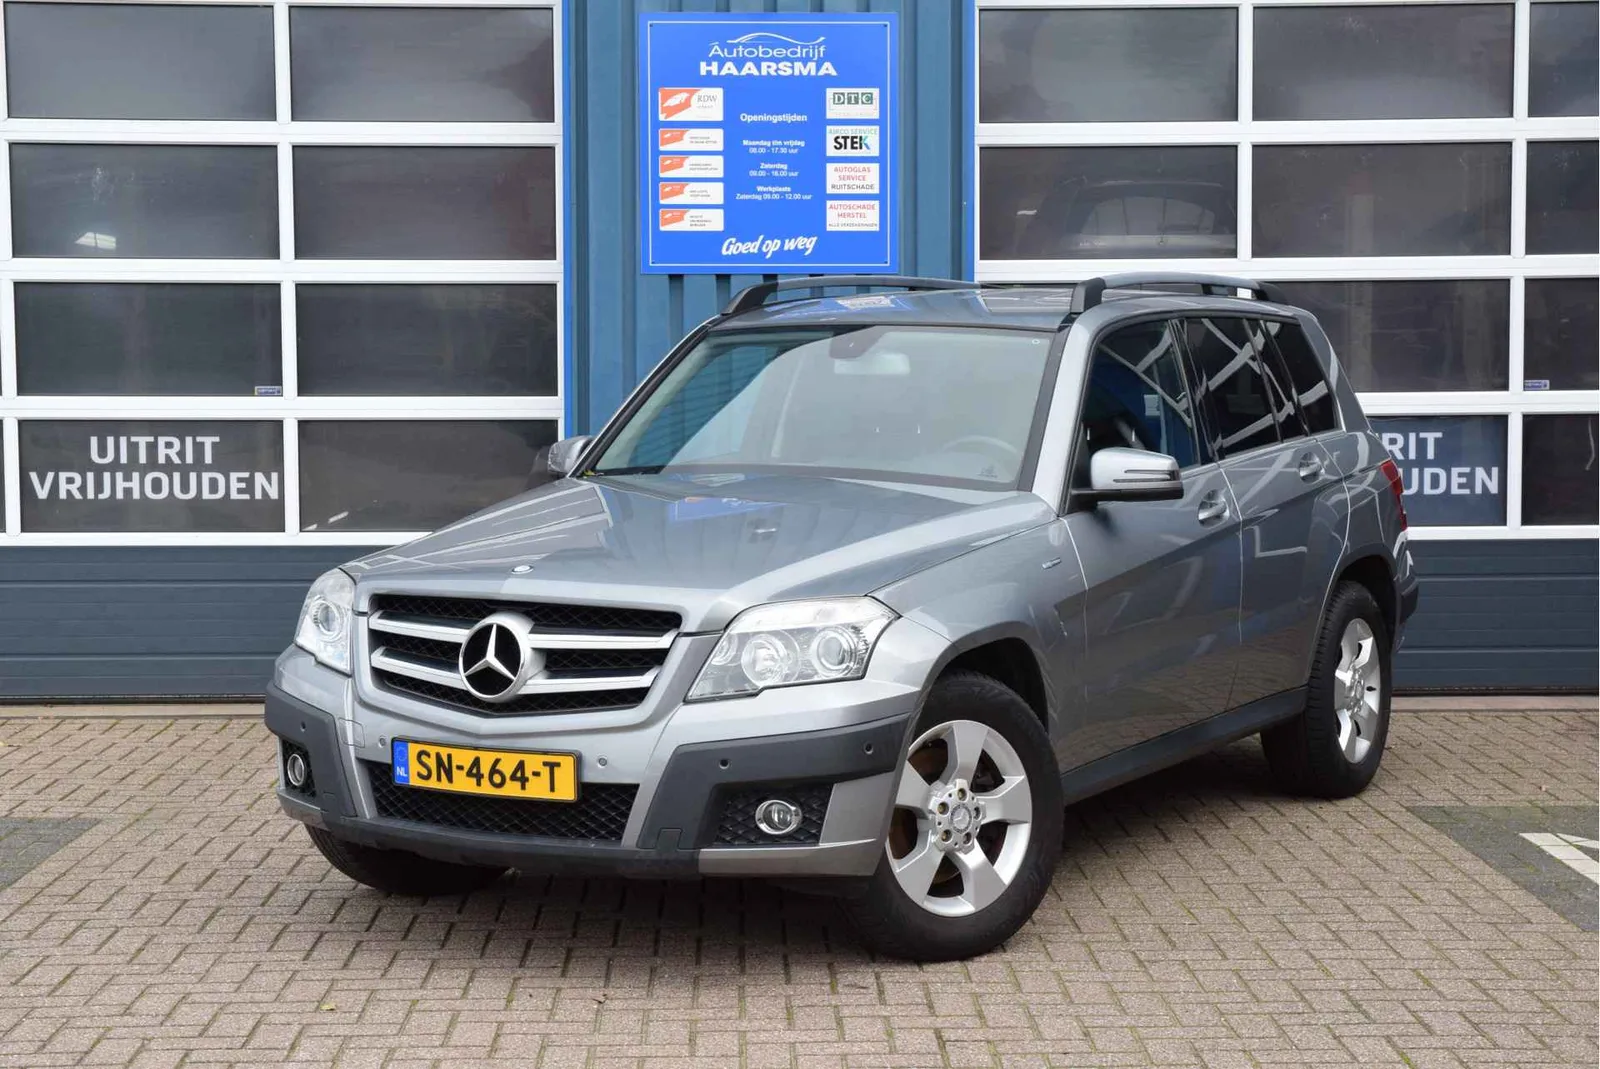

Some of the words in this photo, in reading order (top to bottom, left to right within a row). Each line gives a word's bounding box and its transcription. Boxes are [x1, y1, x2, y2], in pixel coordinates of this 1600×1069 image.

[709, 45, 826, 60] Autobedrijf
[700, 61, 838, 76] HAARSMA
[833, 92, 873, 104] DTC
[740, 113, 808, 123] Openingstijden
[833, 136, 870, 150] STEK
[722, 235, 764, 256] Goed
[762, 239, 781, 259] op
[784, 236, 818, 256] weg
[90, 436, 220, 464] UITRIT
[29, 472, 279, 500] VRIJHOUDEN
[396, 766, 408, 777] NL
[416, 749, 561, 793] SN-464-T
